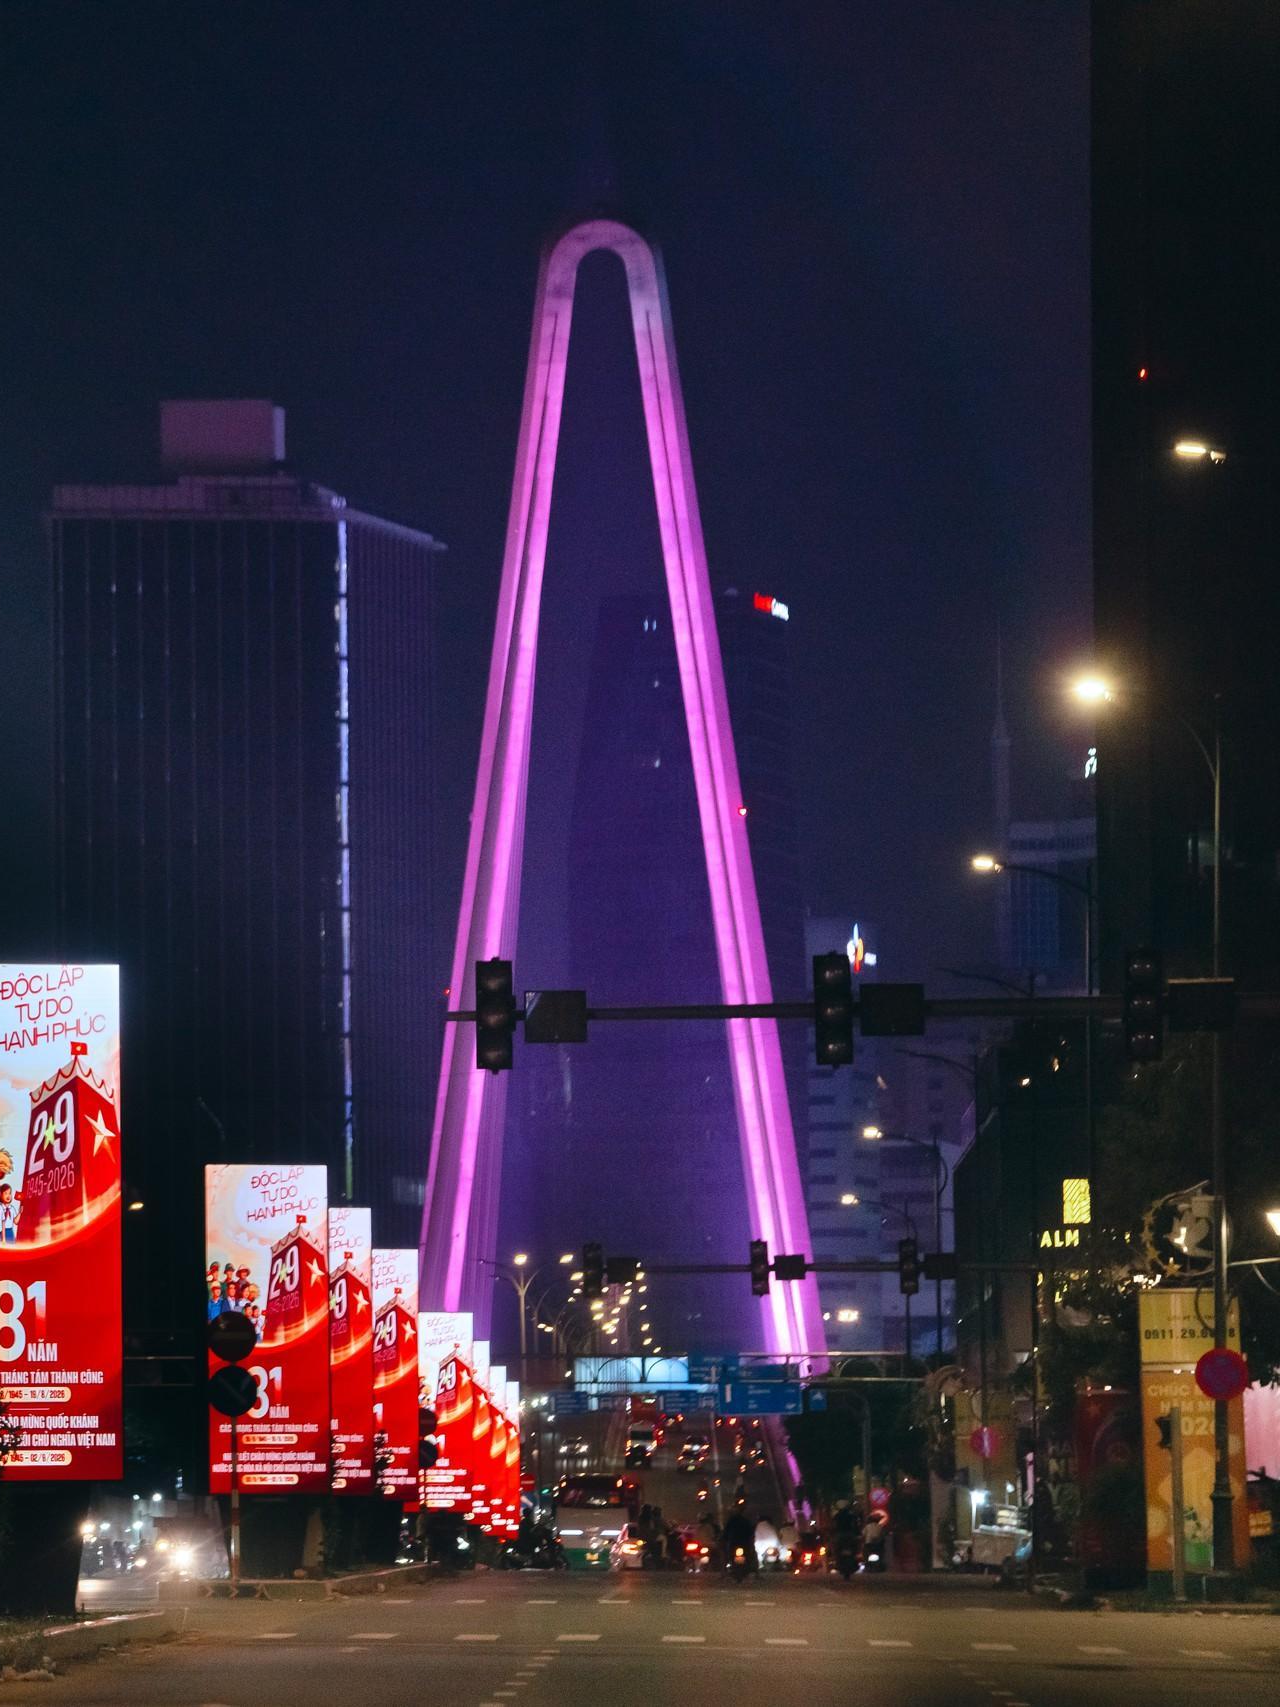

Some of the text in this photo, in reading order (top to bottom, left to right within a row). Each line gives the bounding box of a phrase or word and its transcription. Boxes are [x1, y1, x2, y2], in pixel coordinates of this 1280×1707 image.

[0, 973, 43, 1000] ĐỘC
[15, 996, 73, 1024] TỰ DO
[53, 1012, 106, 1042] PHÚC
[27, 1339, 57, 1362] NĂM
[0, 1369, 28, 1384] THÁNG
[30, 1369, 48, 1384] TÁM
[80, 1369, 104, 1384] CÔNG
